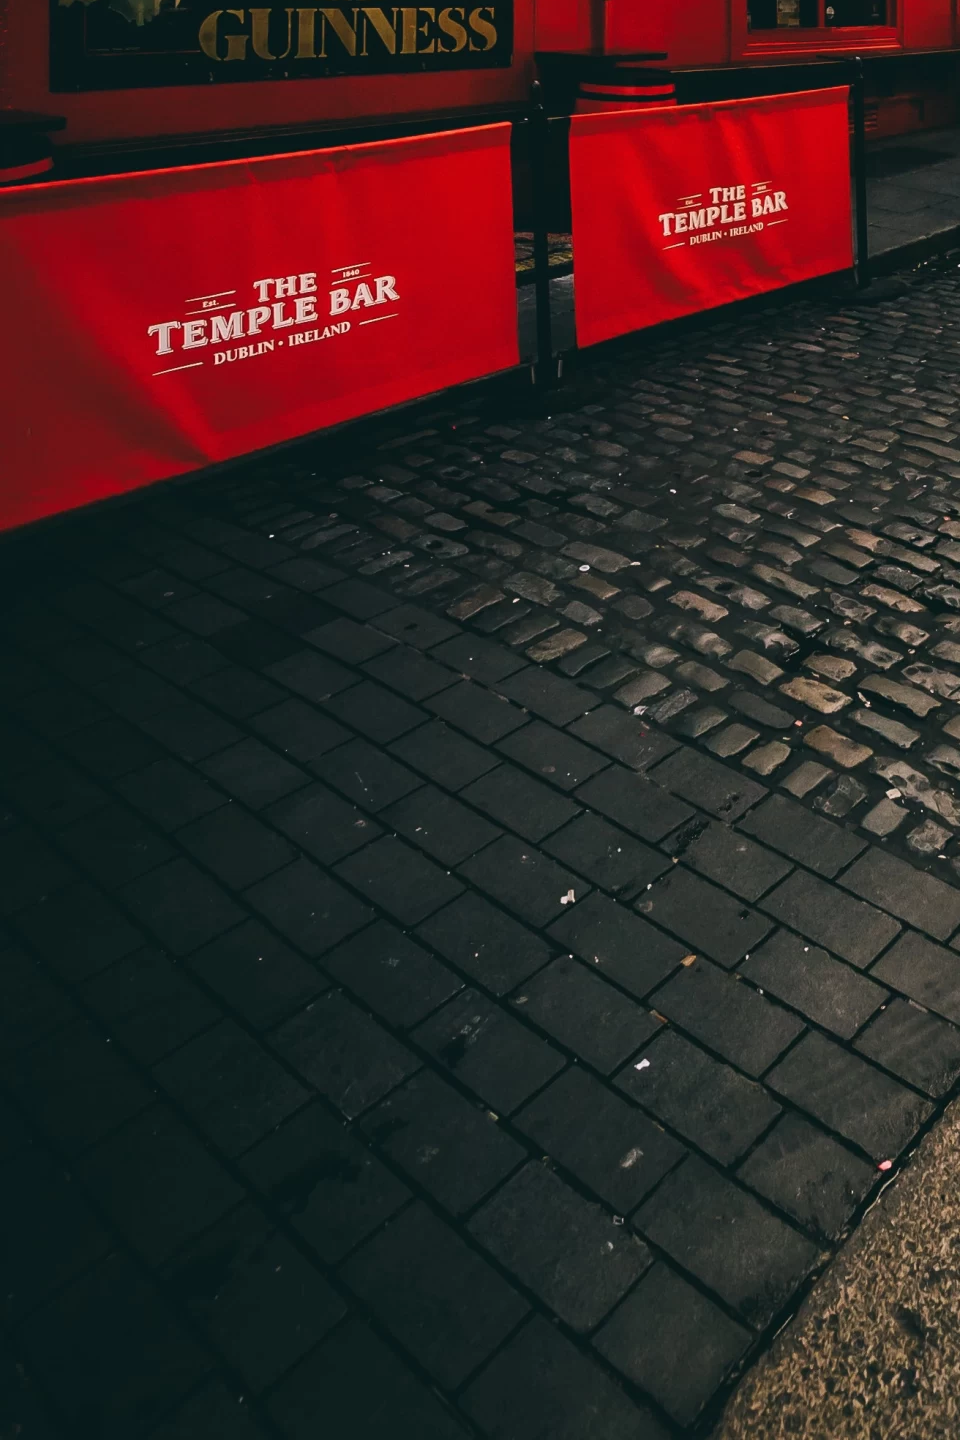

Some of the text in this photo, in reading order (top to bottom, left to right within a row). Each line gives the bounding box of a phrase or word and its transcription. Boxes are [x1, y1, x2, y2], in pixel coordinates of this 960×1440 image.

[198, 6, 498, 62] GUINNESS
[709, 185, 746, 204] THE
[658, 191, 789, 237] TEMPLE BAR
[689, 222, 764, 246] DUBLIN IRELAND
[253, 272, 318, 303] THE
[342, 268, 360, 279] 1840
[147, 274, 400, 356] TEMPLE BAR
[202, 298, 220, 308] Est.
[213, 321, 351, 366] DUBLIN IRELAND
